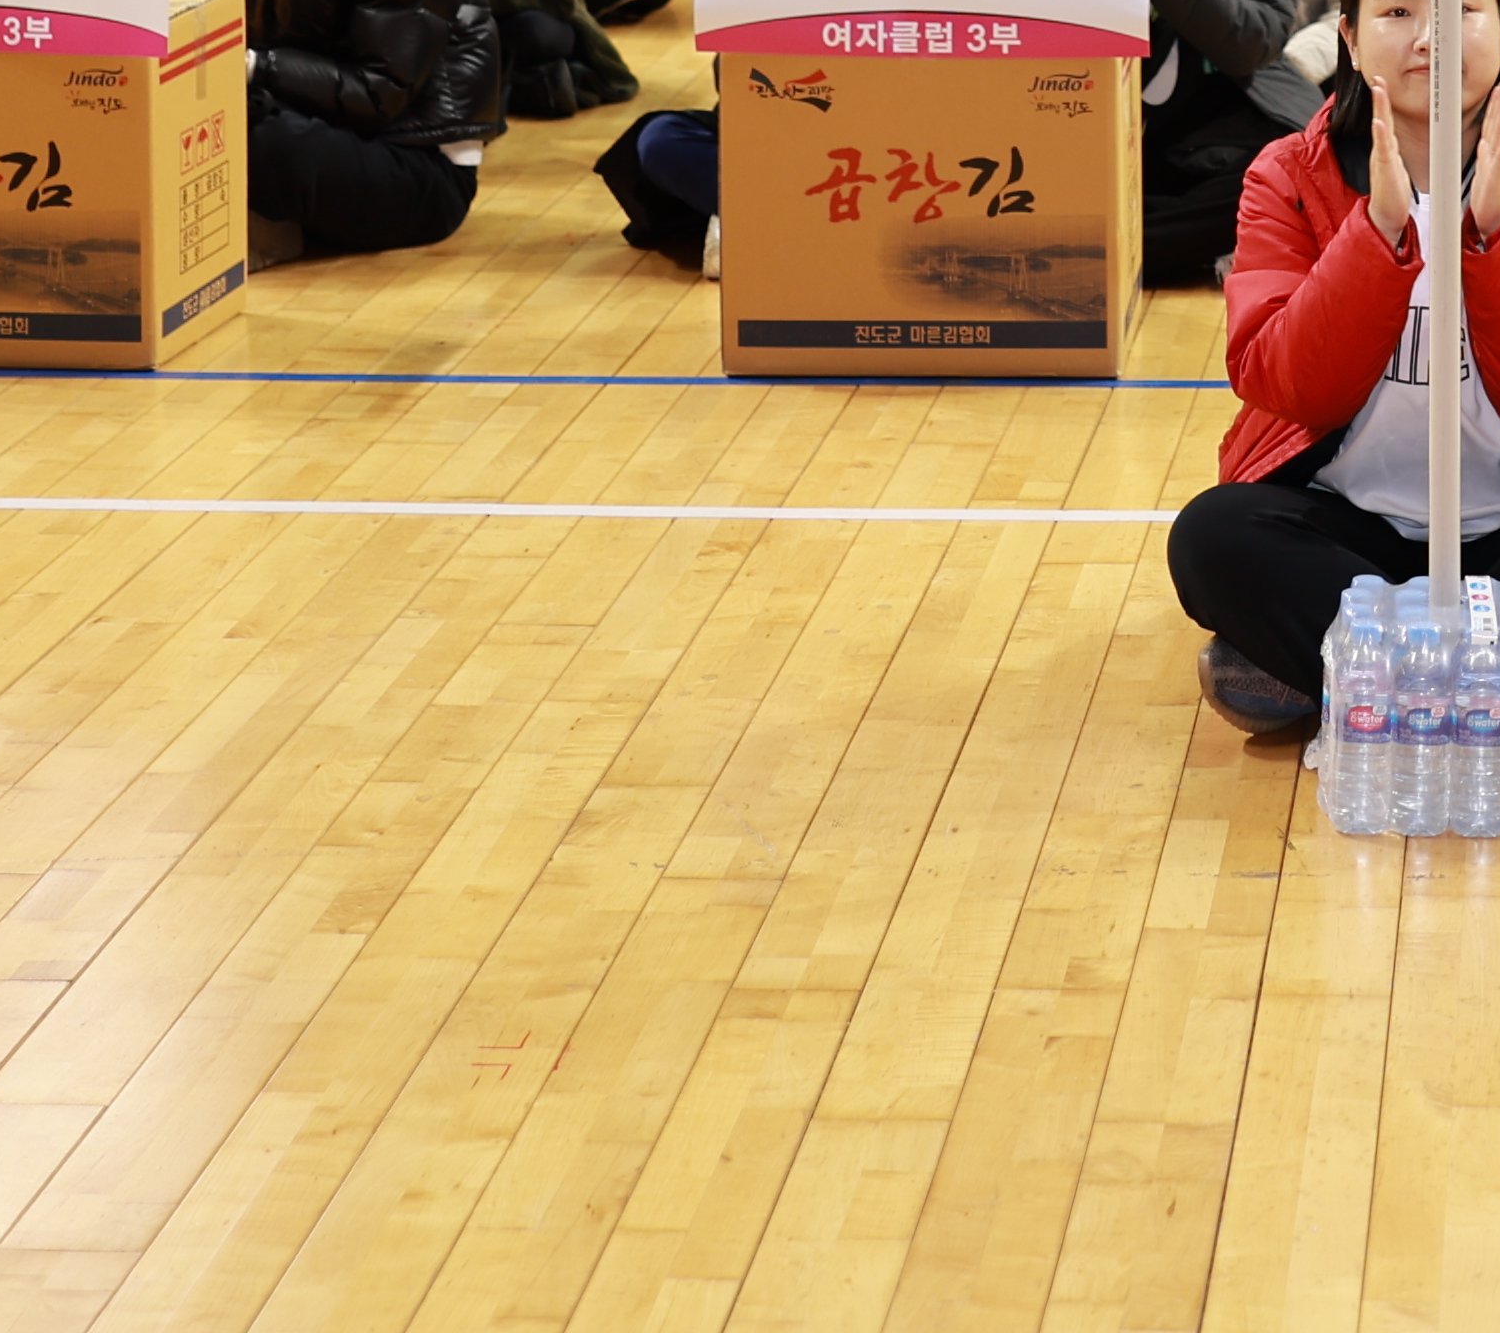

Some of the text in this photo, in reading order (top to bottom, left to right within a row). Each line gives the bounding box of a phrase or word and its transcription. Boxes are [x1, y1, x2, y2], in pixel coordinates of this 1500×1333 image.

[2, 16, 54, 48] 3부
[822, 21, 1022, 54] 여자클럽 3부
[65, 71, 118, 87] Jindo
[1028, 76, 1083, 93] Jindo
[805, 146, 1036, 224] 곱창김
[854, 326, 991, 344] 진도군 마른김협회
